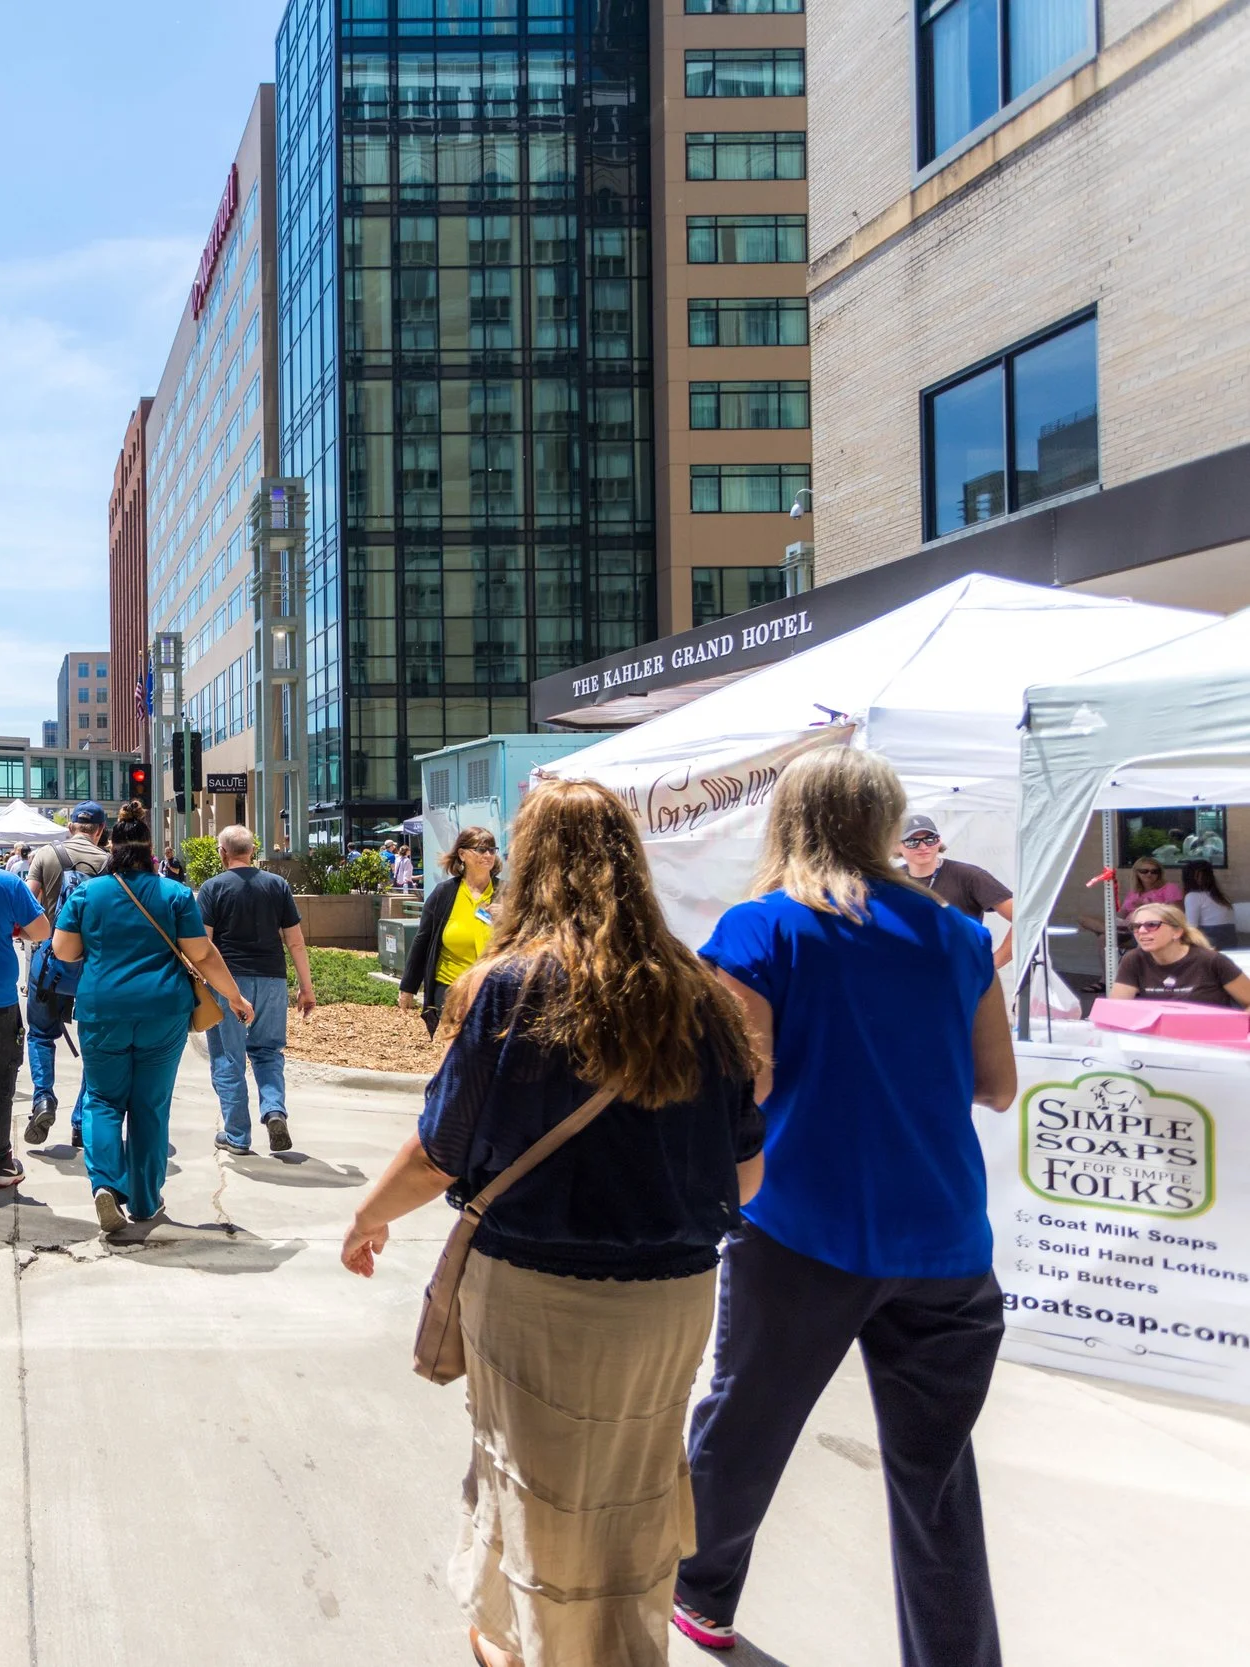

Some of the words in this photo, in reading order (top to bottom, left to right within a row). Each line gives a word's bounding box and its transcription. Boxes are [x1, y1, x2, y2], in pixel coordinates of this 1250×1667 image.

[572, 674, 599, 698] THE
[603, 654, 664, 689] KAHLER
[671, 634, 734, 669] GRAND
[741, 610, 813, 651] HOTEL
[208, 777, 246, 787] SALUTE!
[1036, 1098, 1194, 1142] SIMPLE
[1034, 1132, 1198, 1166] SOAPS
[1041, 1157, 1194, 1209] FOLKS
[1082, 1162, 1117, 1174] FOR
[1122, 1166, 1193, 1185] SIMPLE
[1037, 1213, 1088, 1232] Goat
[1095, 1222, 1140, 1240] Milk
[1147, 1229, 1218, 1251] Soaps
[1037, 1238, 1090, 1257] Solid
[1097, 1249, 1154, 1268] Hand
[1162, 1257, 1250, 1284] Lotions
[1038, 1263, 1069, 1282] Lip
[1077, 1270, 1159, 1295] Butters
